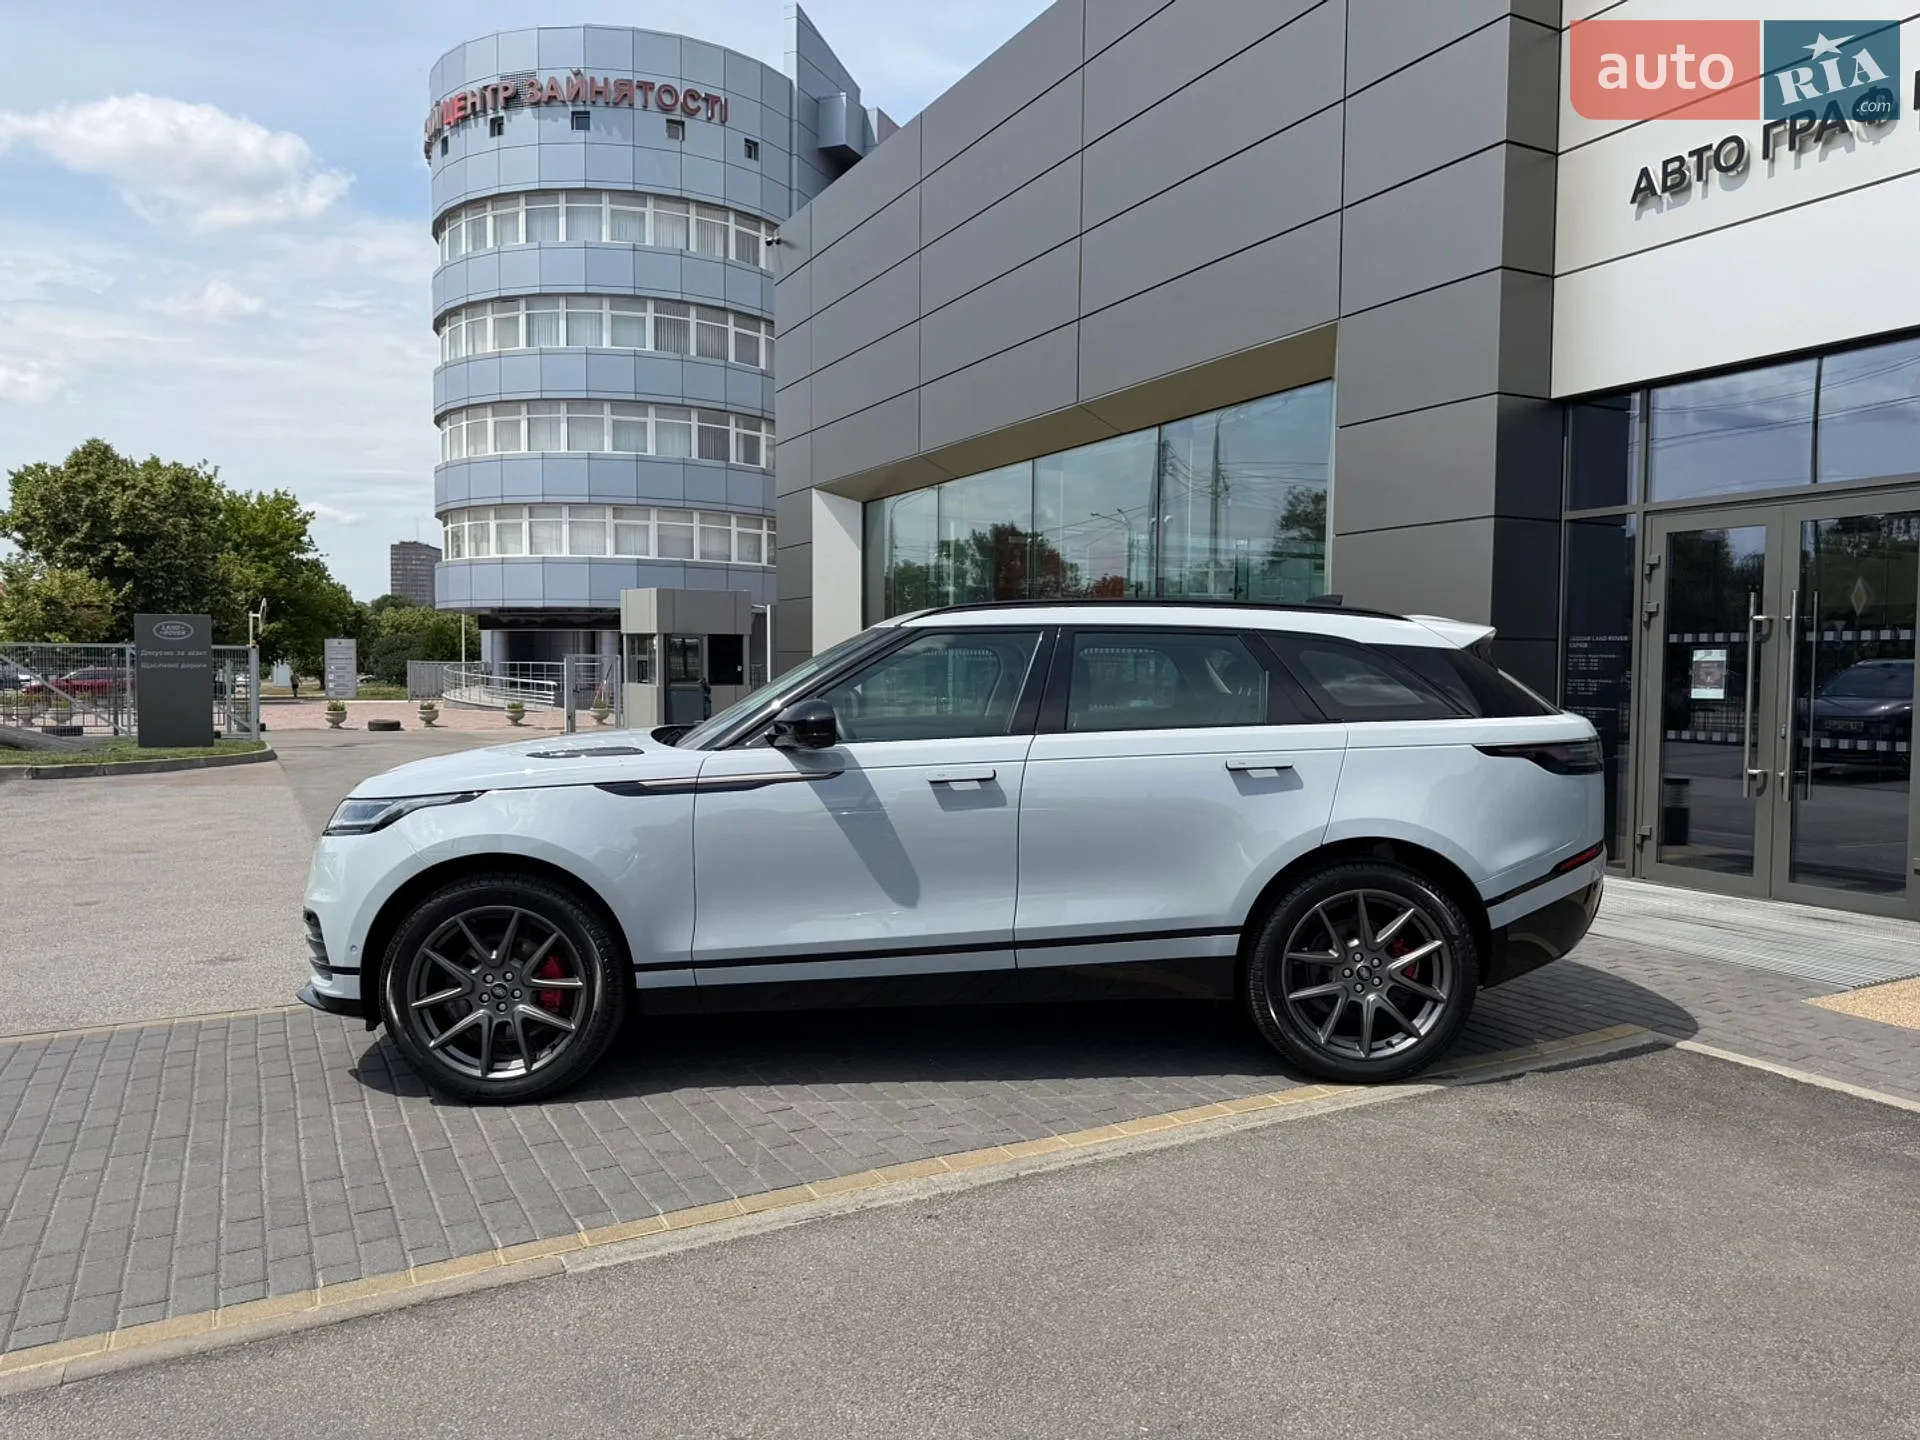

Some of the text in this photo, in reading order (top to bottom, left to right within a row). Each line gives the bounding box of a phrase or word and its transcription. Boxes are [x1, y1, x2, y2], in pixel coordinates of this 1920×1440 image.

[442, 81, 518, 128] ЦЕНТР
[524, 67, 730, 124] ЗАЙНЯТОСТІ
[1629, 134, 1748, 206] АВТО
